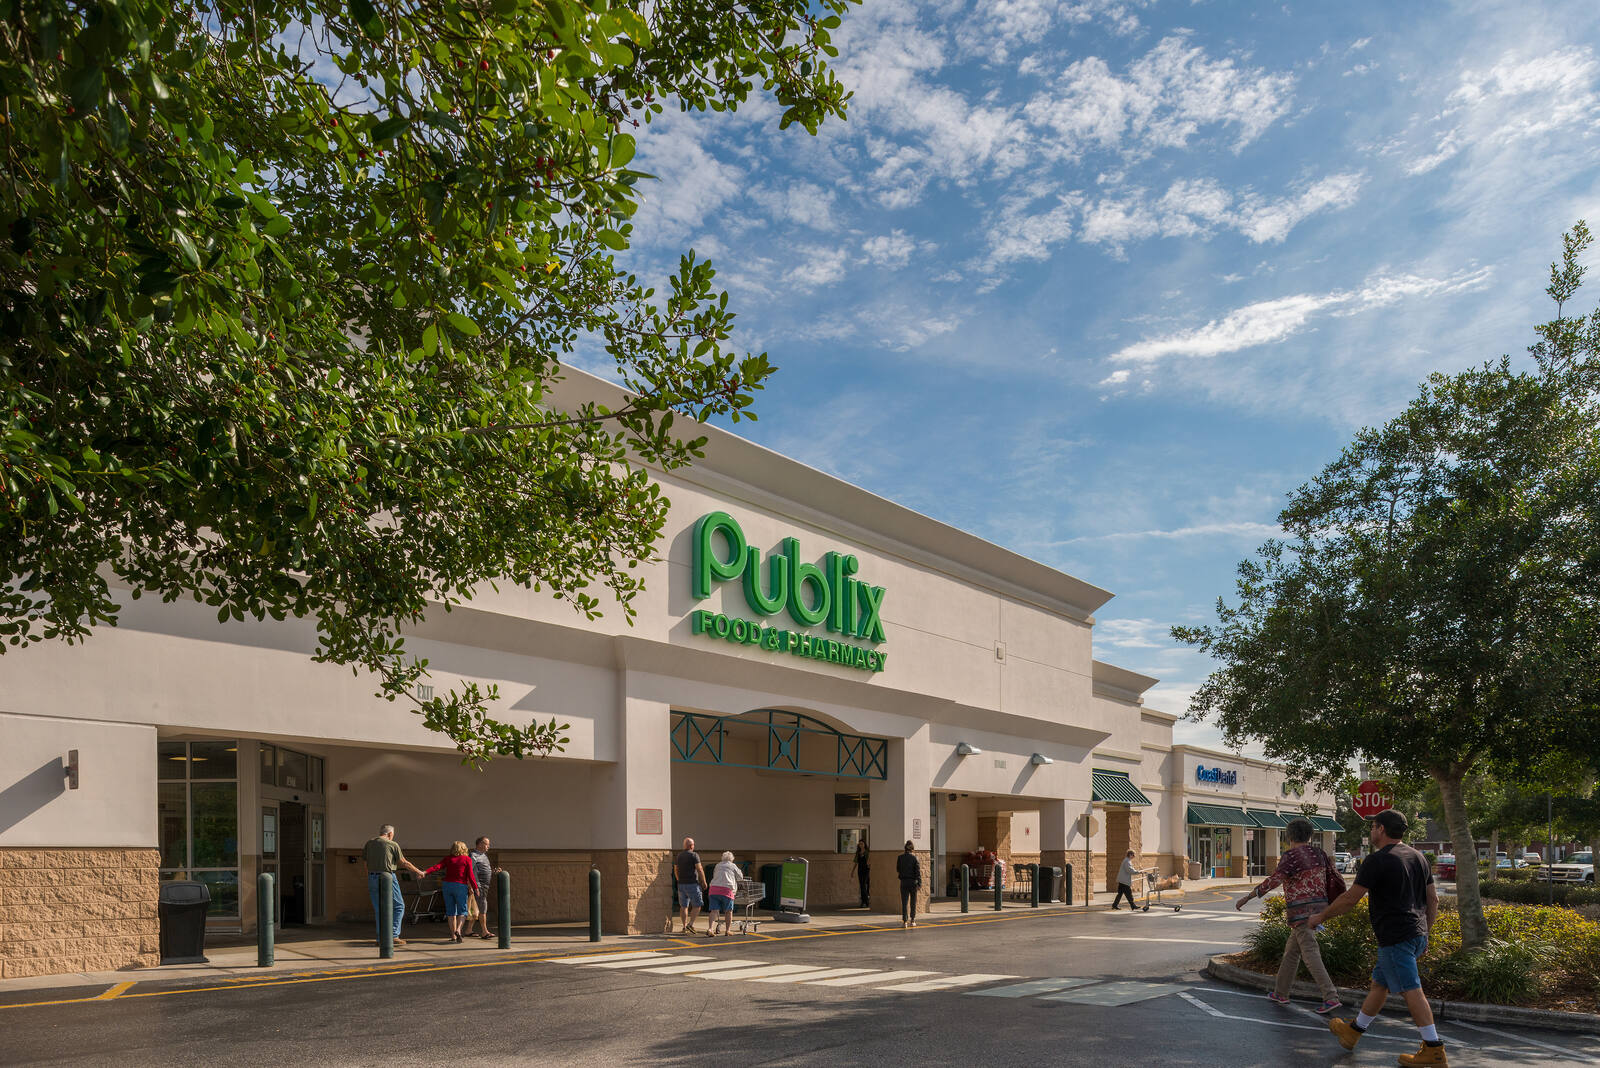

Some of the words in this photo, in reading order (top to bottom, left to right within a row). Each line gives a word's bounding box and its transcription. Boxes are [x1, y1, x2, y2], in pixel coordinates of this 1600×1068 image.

[692, 511, 887, 643] Publix
[692, 610, 762, 643] FOOD
[762, 627, 780, 651] &
[779, 630, 888, 672] PHARMACY
[417, 685, 434, 700] EXIT
[1355, 792, 1390, 808] STOP
